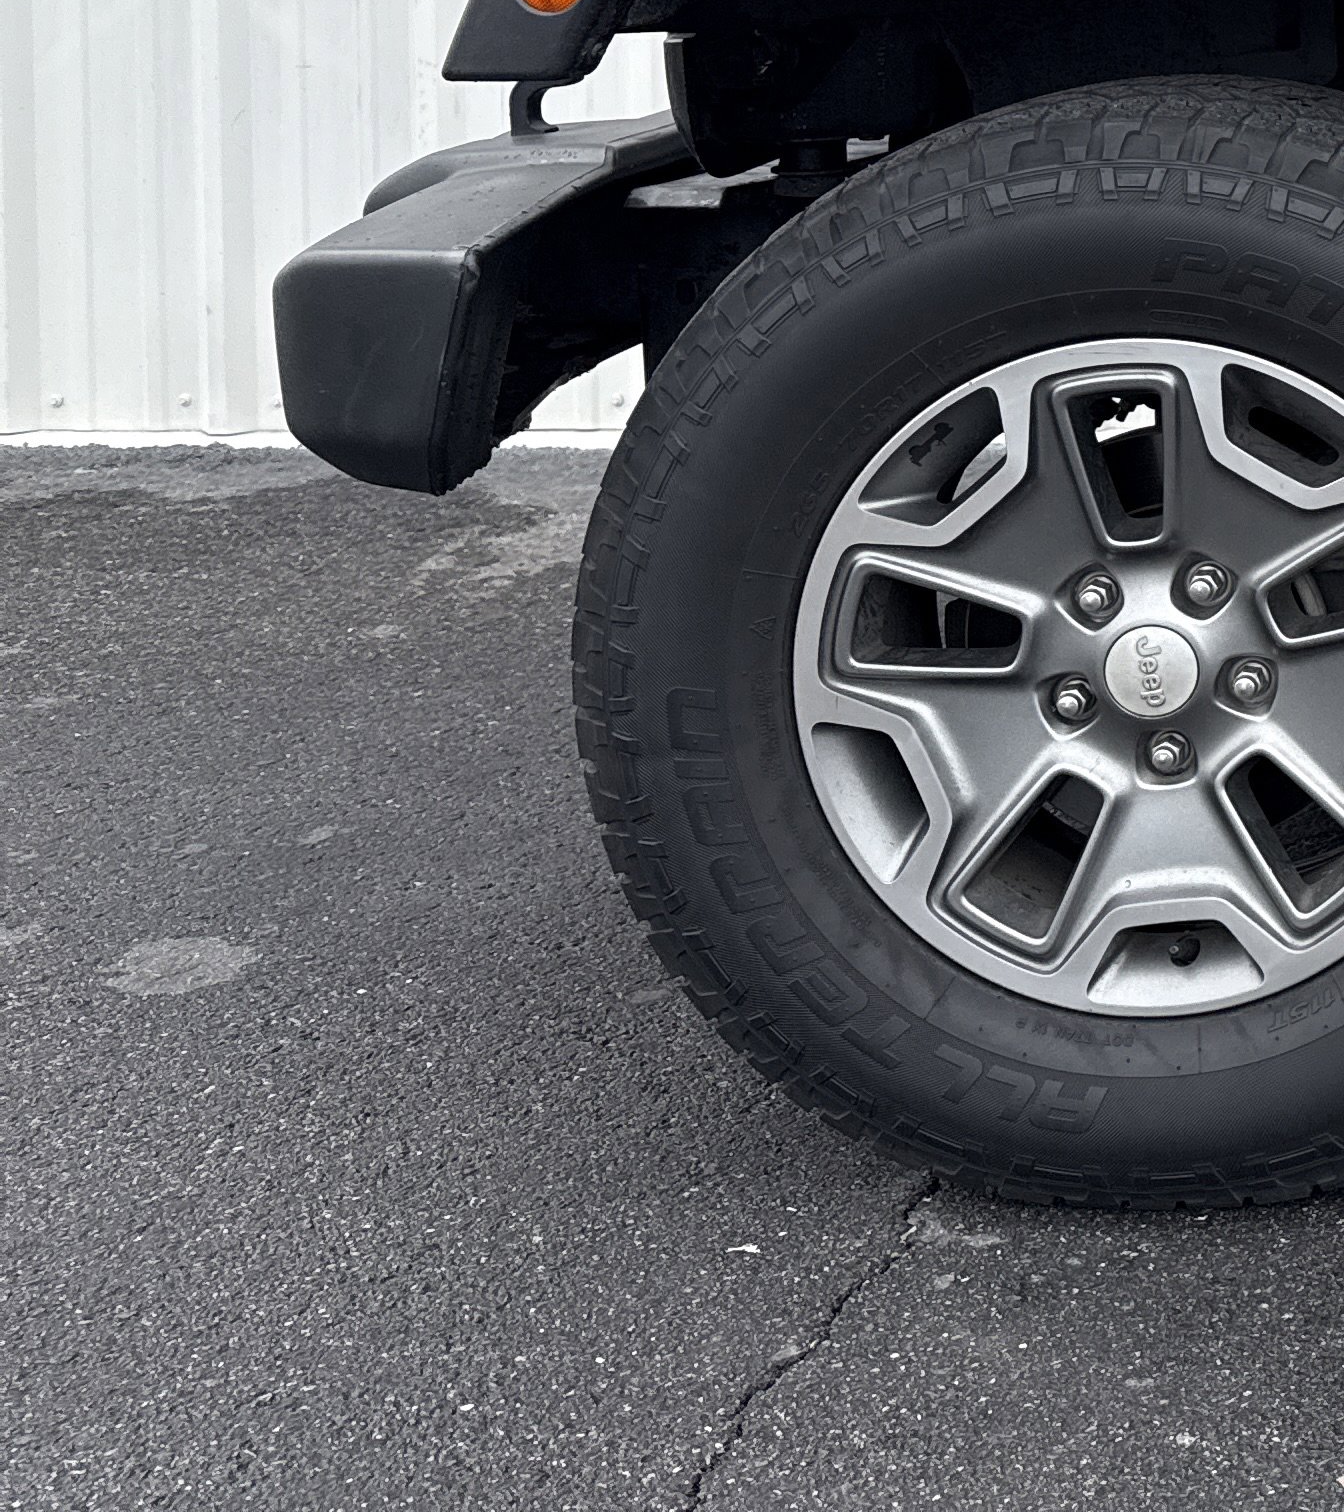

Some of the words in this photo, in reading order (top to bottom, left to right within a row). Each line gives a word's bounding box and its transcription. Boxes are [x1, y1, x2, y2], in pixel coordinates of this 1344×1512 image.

[1136, 635, 1166, 708] Jeep
[667, 687, 912, 1069] TERRAIN
[1267, 990, 1336, 1034] 115T
[934, 1043, 1108, 1133] ALL
